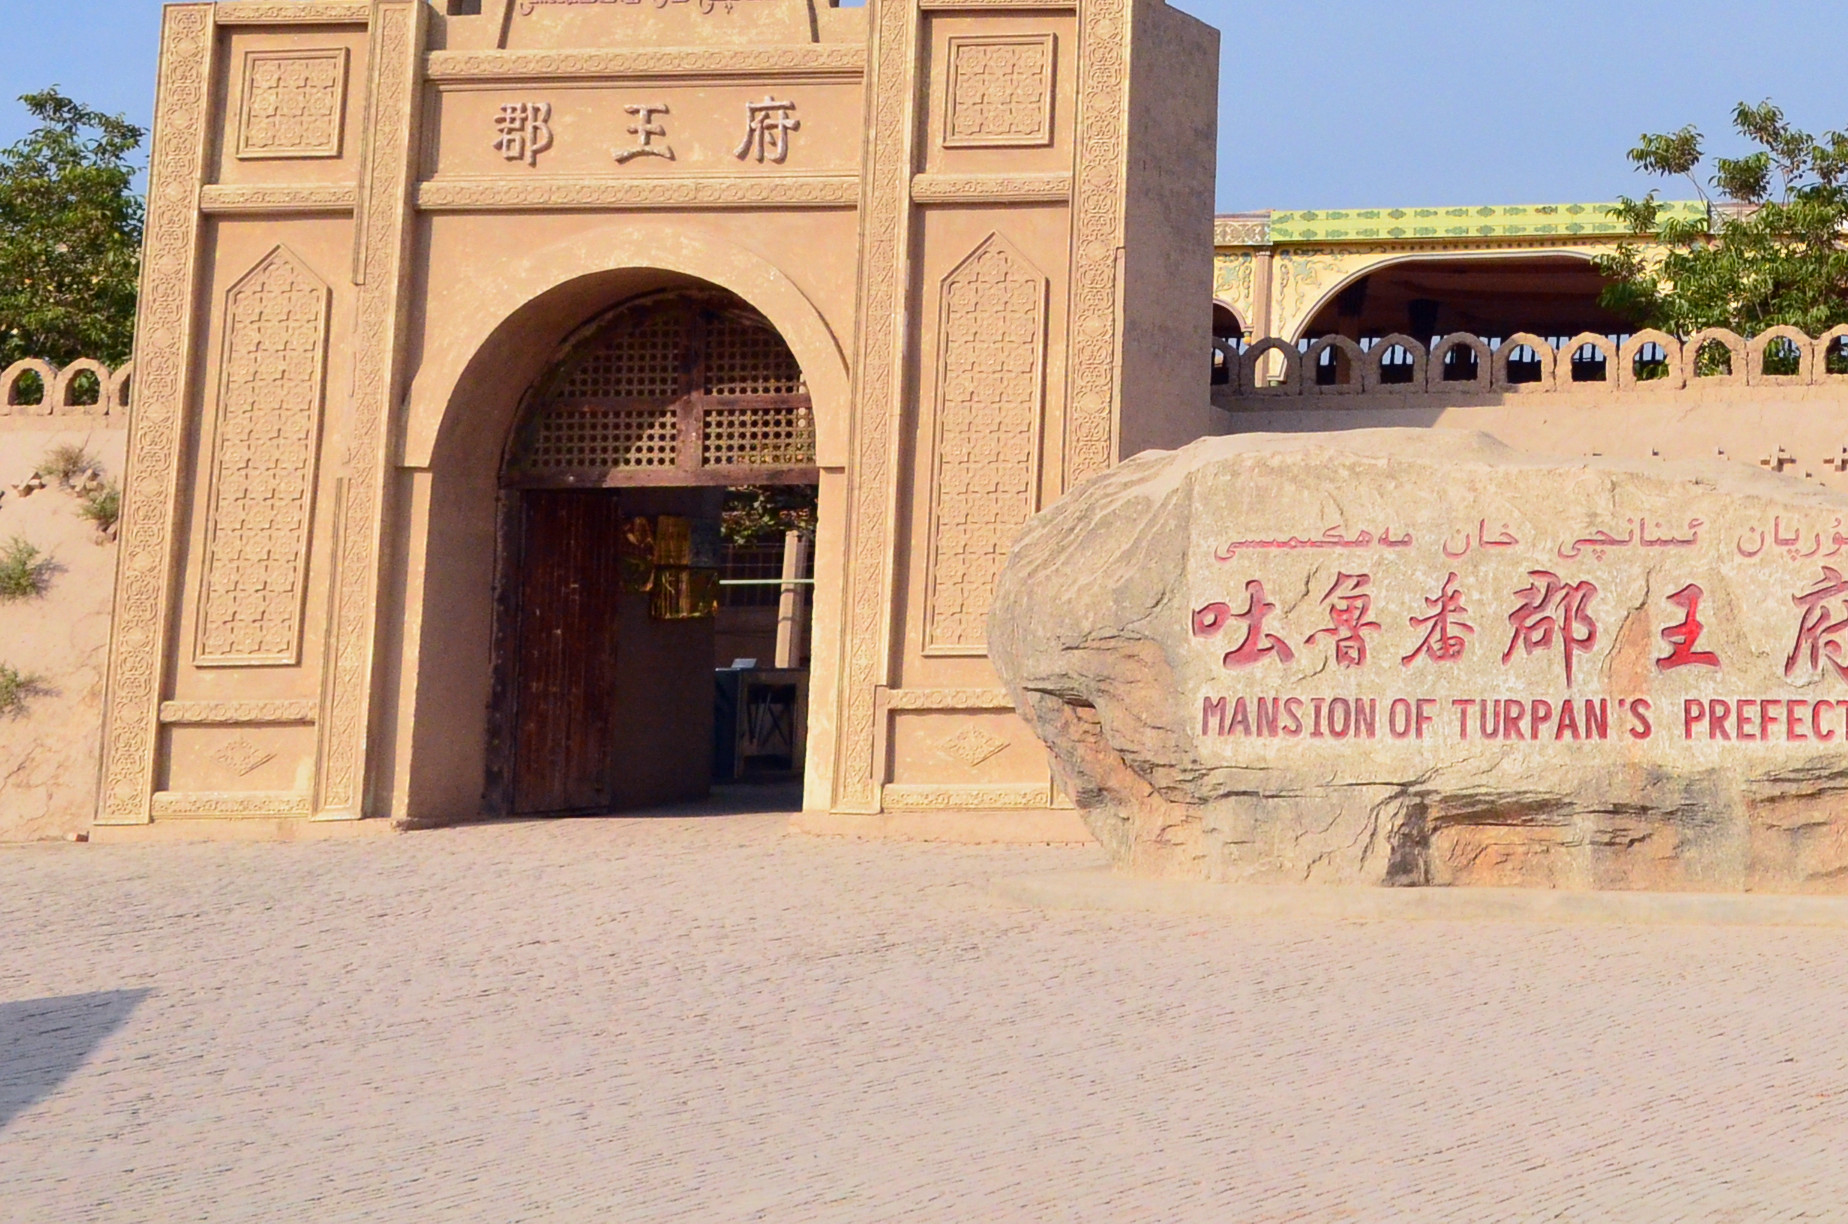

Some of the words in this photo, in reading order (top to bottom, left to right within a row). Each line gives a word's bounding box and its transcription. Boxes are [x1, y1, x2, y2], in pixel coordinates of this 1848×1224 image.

[493, 95, 800, 167] 郡王府
[1442, 518, 1520, 560] خان
[1201, 696, 1377, 740] MANSION
[1388, 698, 1437, 740] OF
[1452, 698, 1652, 742] TURPAN'S
